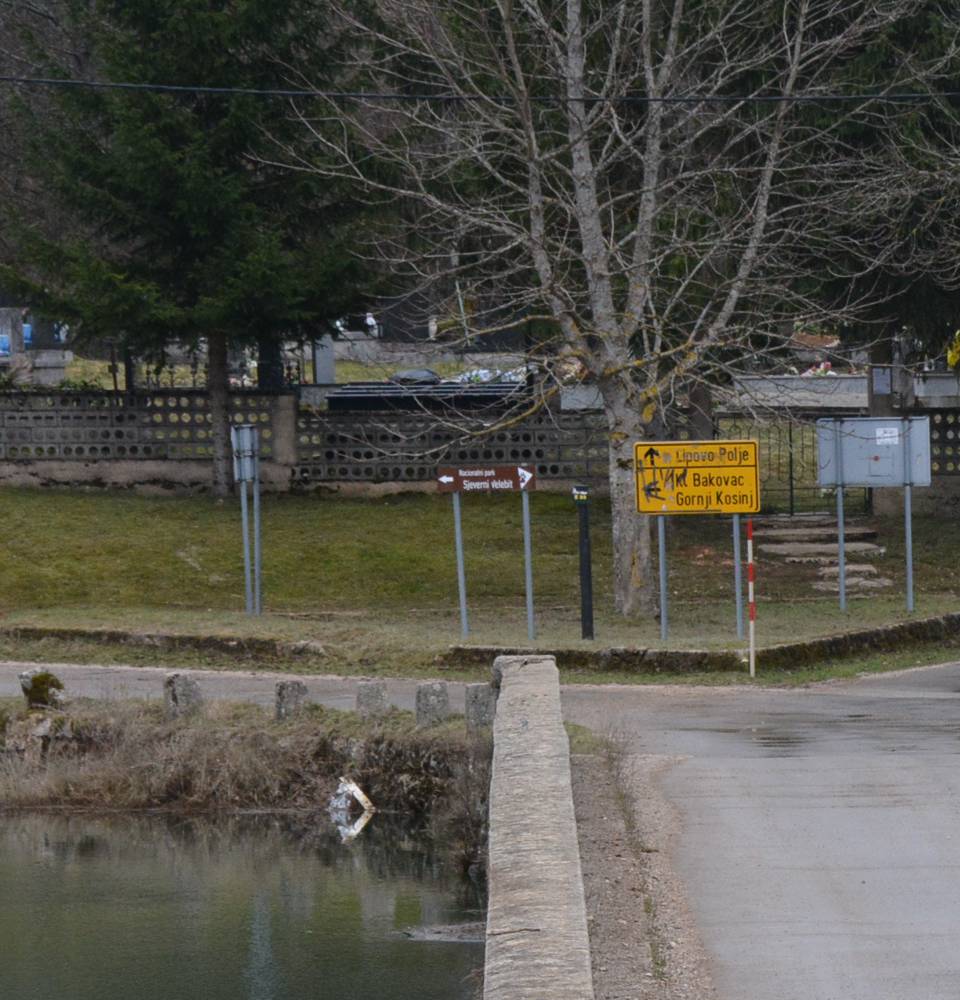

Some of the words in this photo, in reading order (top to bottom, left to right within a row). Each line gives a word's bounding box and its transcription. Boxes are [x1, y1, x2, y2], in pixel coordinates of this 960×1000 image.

[676, 449, 714, 466] Lipovo
[719, 447, 749, 464] Polje
[463, 480, 490, 490] Sjeverni
[491, 480, 513, 489] Velebit
[692, 473, 744, 487] Bakovac
[675, 491, 712, 508] Gornji
[716, 491, 753, 507] Kosinj
